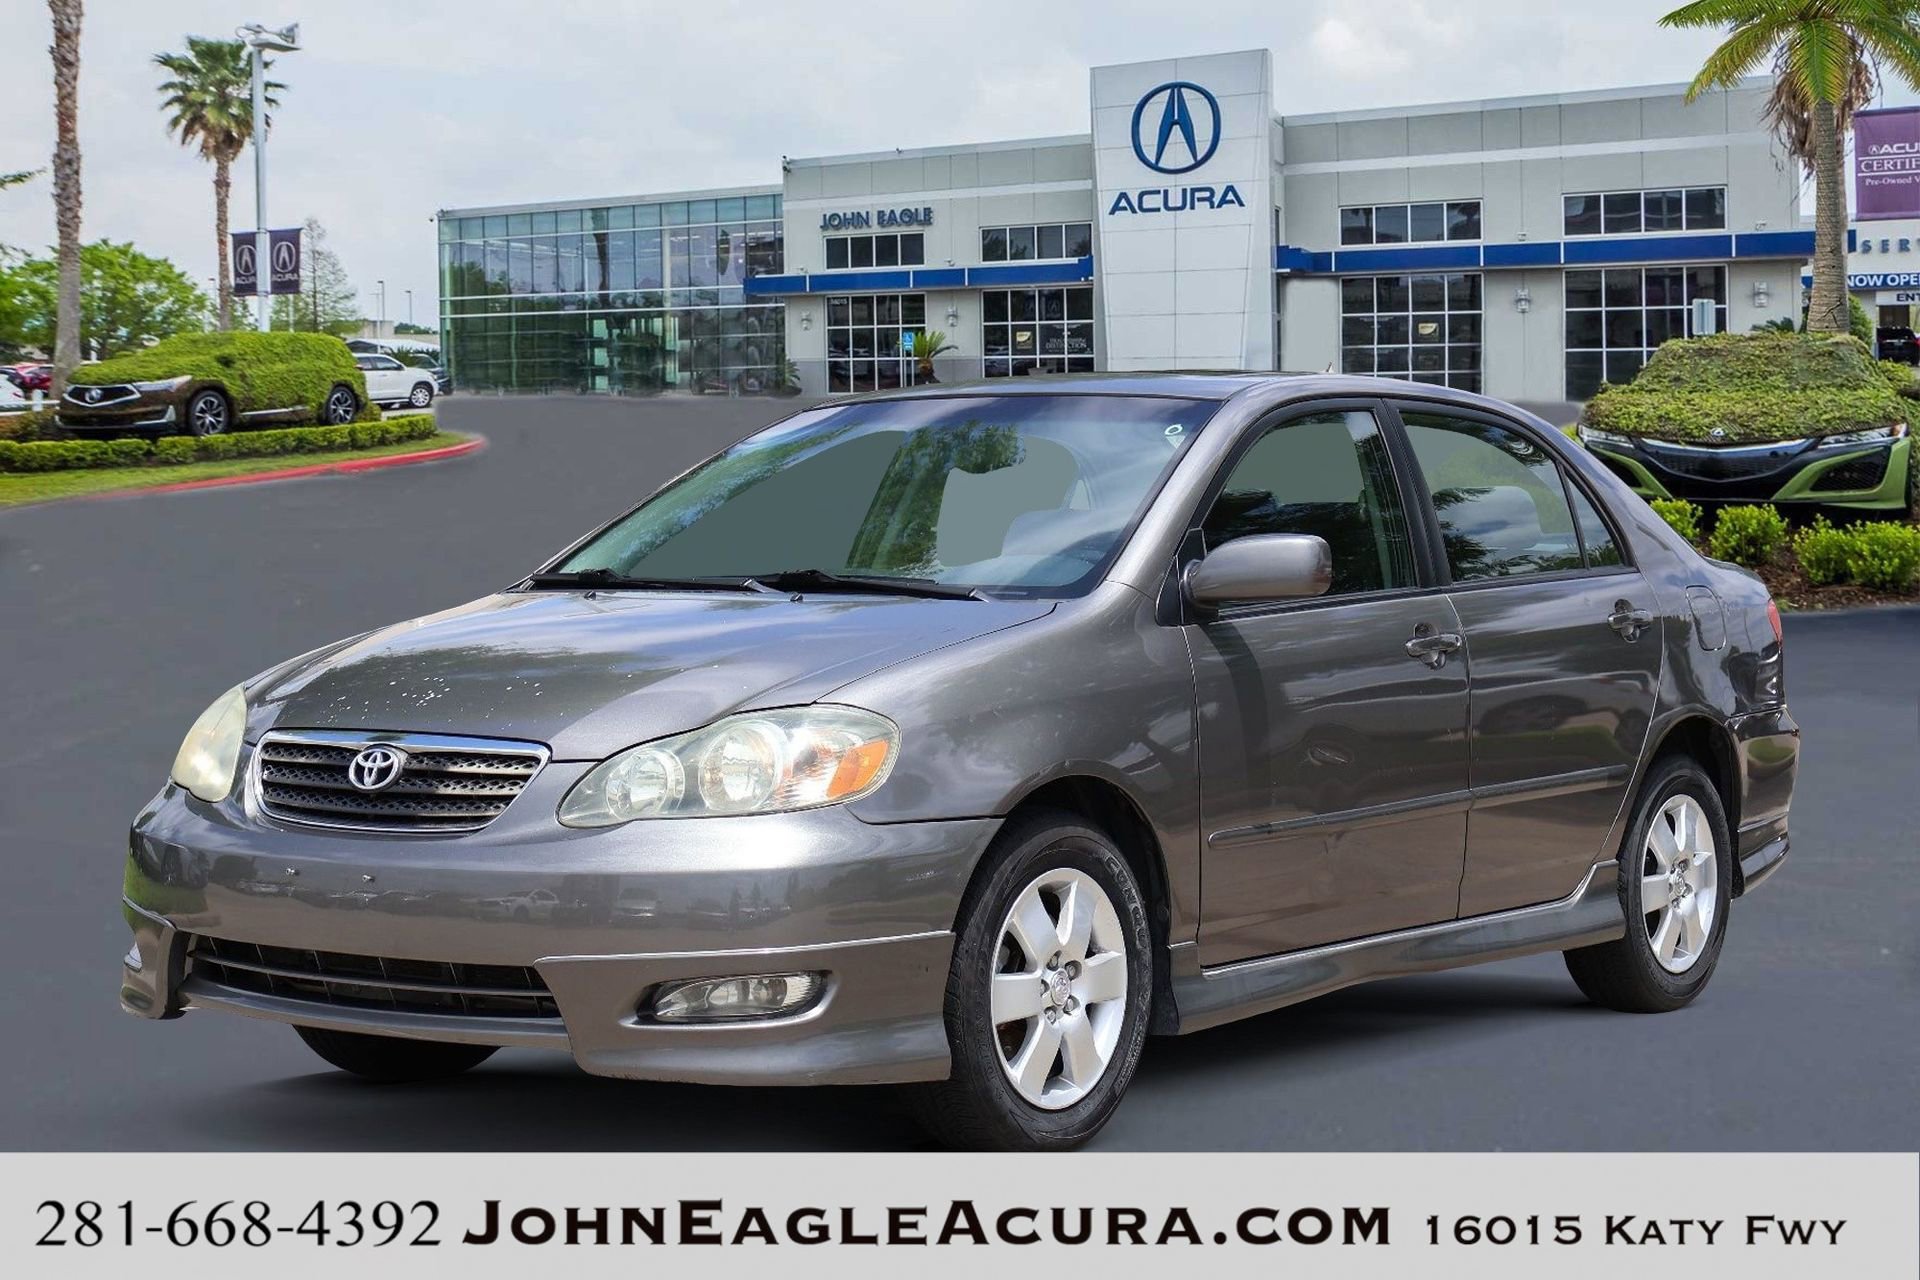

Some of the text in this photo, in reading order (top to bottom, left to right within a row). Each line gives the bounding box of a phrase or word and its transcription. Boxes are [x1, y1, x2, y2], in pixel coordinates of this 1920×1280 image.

[1880, 143, 1920, 154] ACU
[1865, 176, 1912, 186] Pre-Owned
[1108, 184, 1246, 215] ACURA
[820, 206, 934, 231] JOHN EAGLE
[1861, 238, 1920, 254] SER
[271, 273, 299, 282] ACURA
[1847, 273, 1920, 288] NOW OPE
